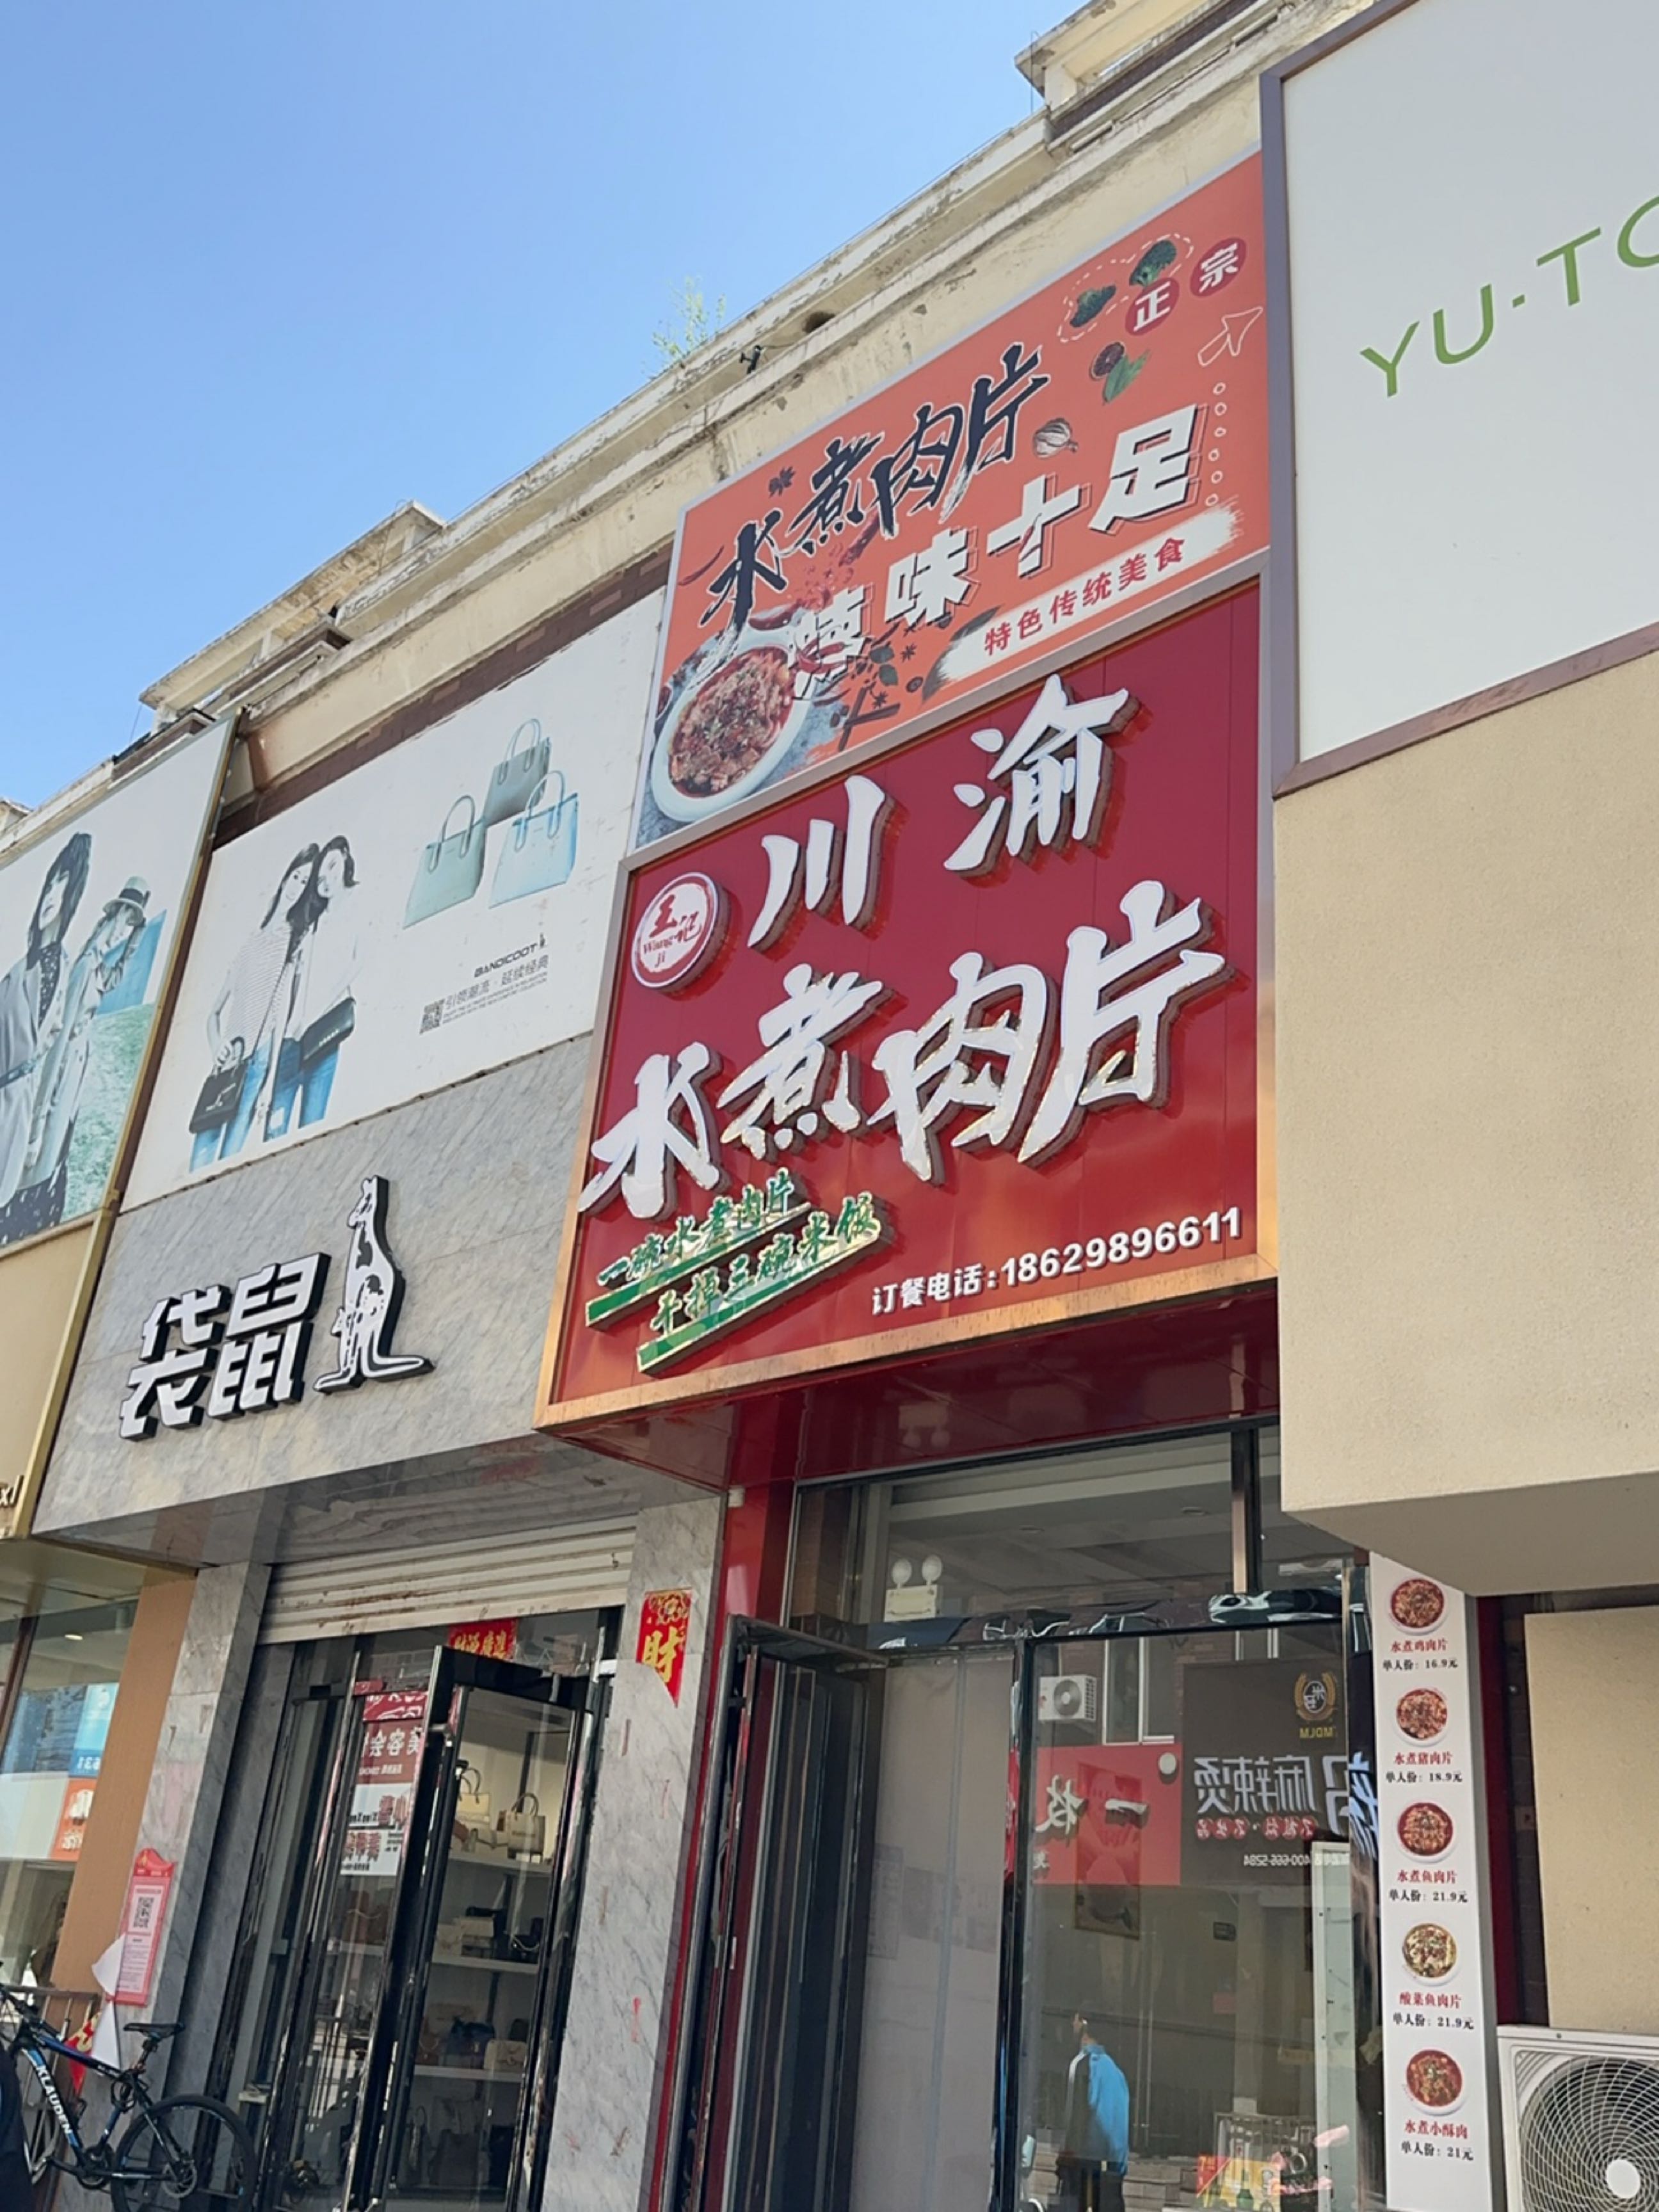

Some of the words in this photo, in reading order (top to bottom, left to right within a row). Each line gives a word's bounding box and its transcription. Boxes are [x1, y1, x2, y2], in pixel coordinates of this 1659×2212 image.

[1133, 242, 1239, 332] 正宗
[699, 342, 1051, 648] 水煮肉片
[984, 536, 1185, 656] 特色传统美食
[748, 673, 1132, 948] 川渝
[578, 880, 1226, 1219] 水煮肉片
[598, 1168, 795, 1285] 一碗水煮肉片
[120, 1253, 328, 1439] 袋鼠
